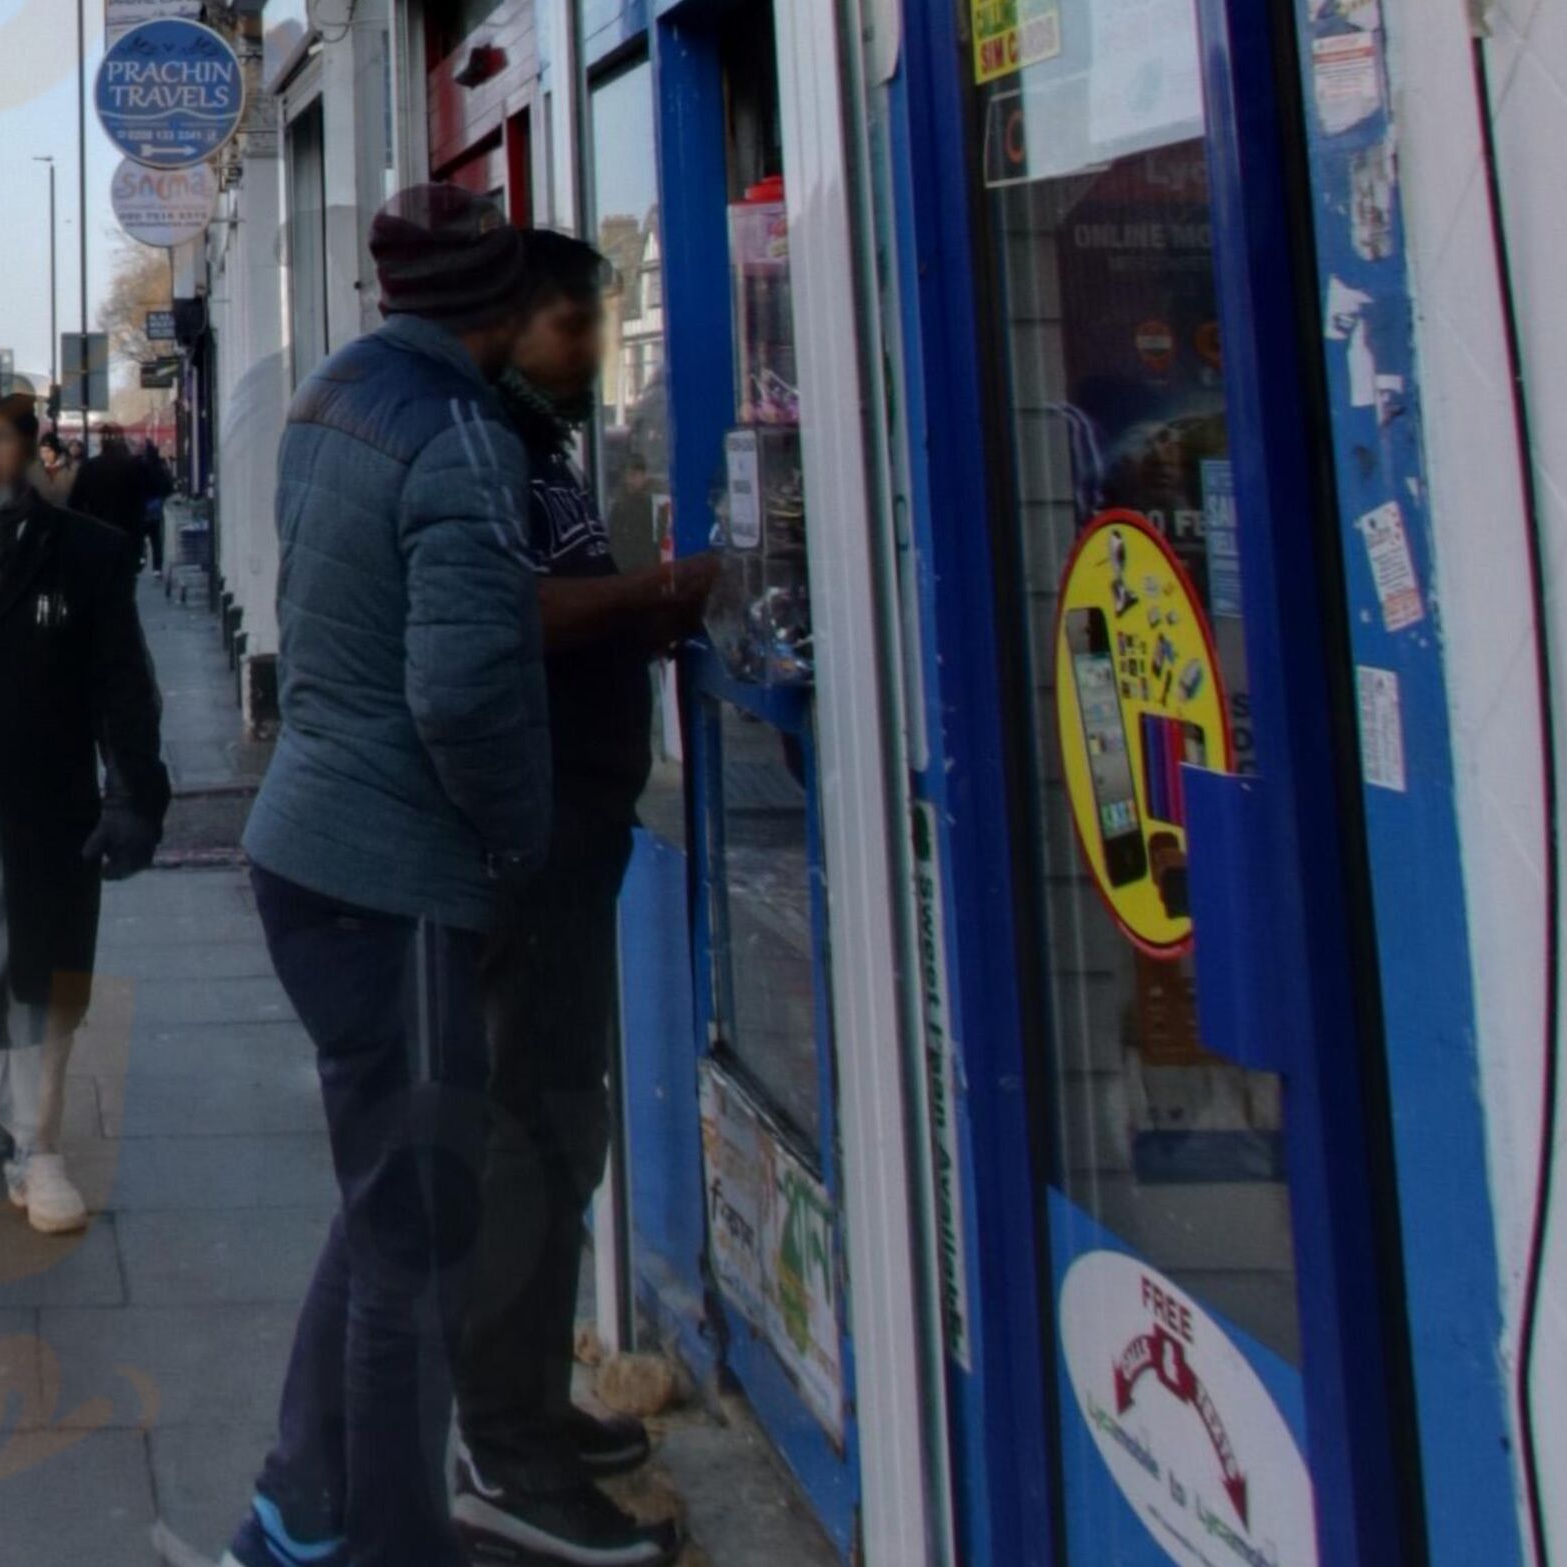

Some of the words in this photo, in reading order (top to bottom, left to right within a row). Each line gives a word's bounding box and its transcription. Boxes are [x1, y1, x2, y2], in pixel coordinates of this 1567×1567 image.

[107, 60, 233, 83] PRACHIN
[109, 85, 230, 108] TRAVELS
[1073, 222, 1167, 249] ONLINE
[917, 875, 943, 1006] Sweet
[1140, 1273, 1195, 1345] FREE
